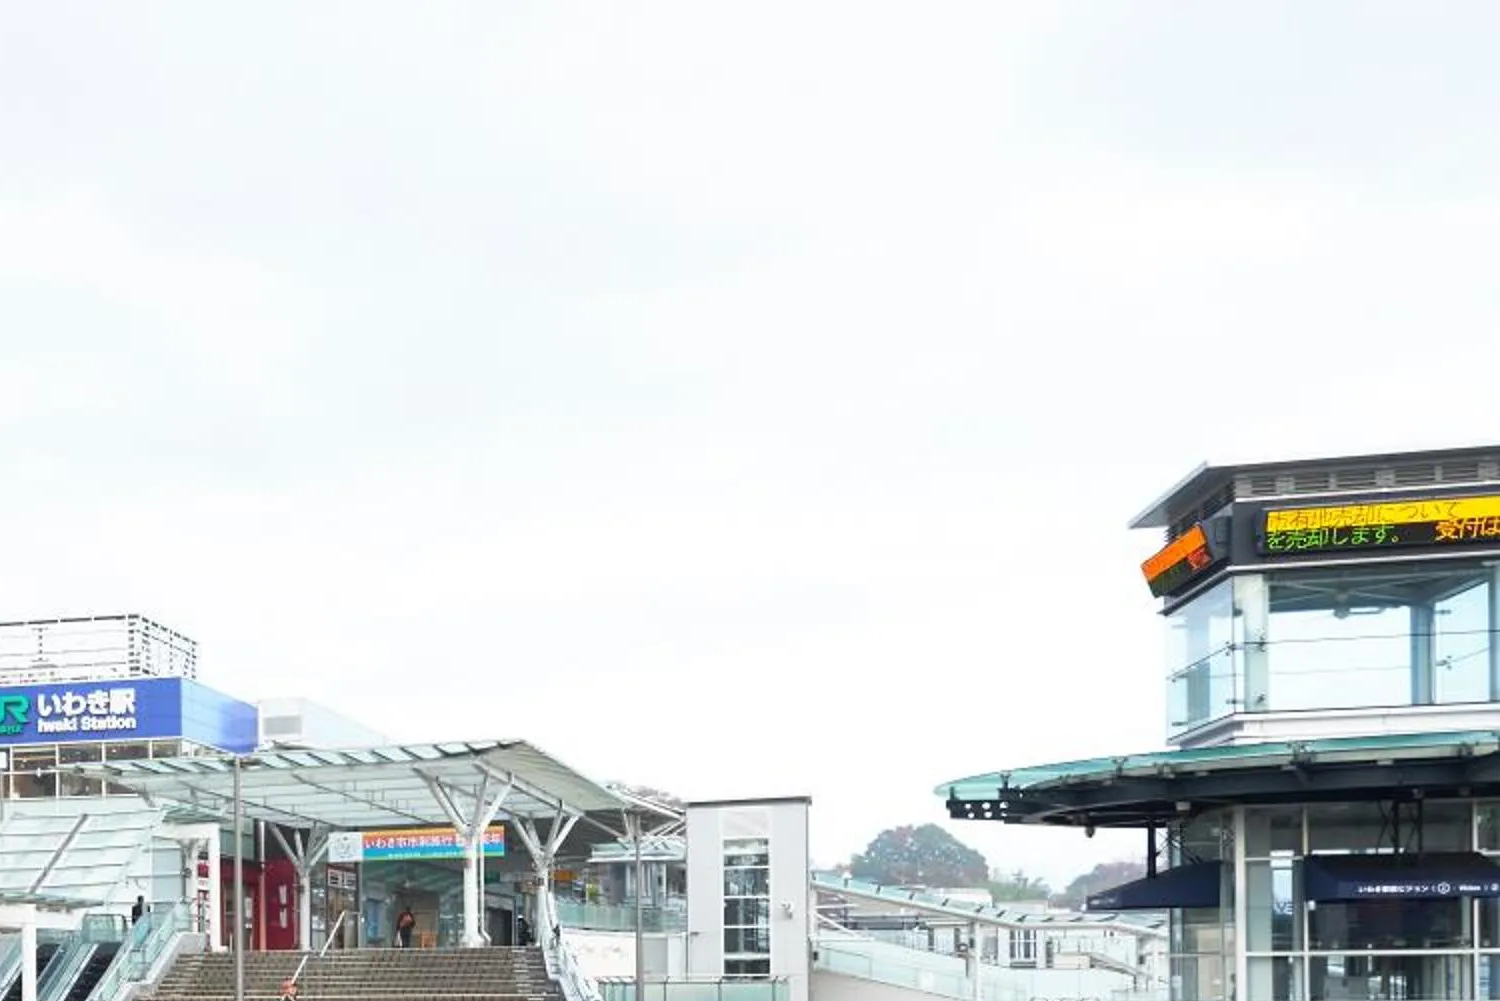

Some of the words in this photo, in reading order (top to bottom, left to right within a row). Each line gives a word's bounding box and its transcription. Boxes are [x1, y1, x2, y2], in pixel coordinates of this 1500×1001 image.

[1267, 525, 1400, 550] を売却します。
[37, 688, 136, 717] いわき駅
[37, 716, 78, 733] Iwaki
[81, 715, 136, 732] Station
